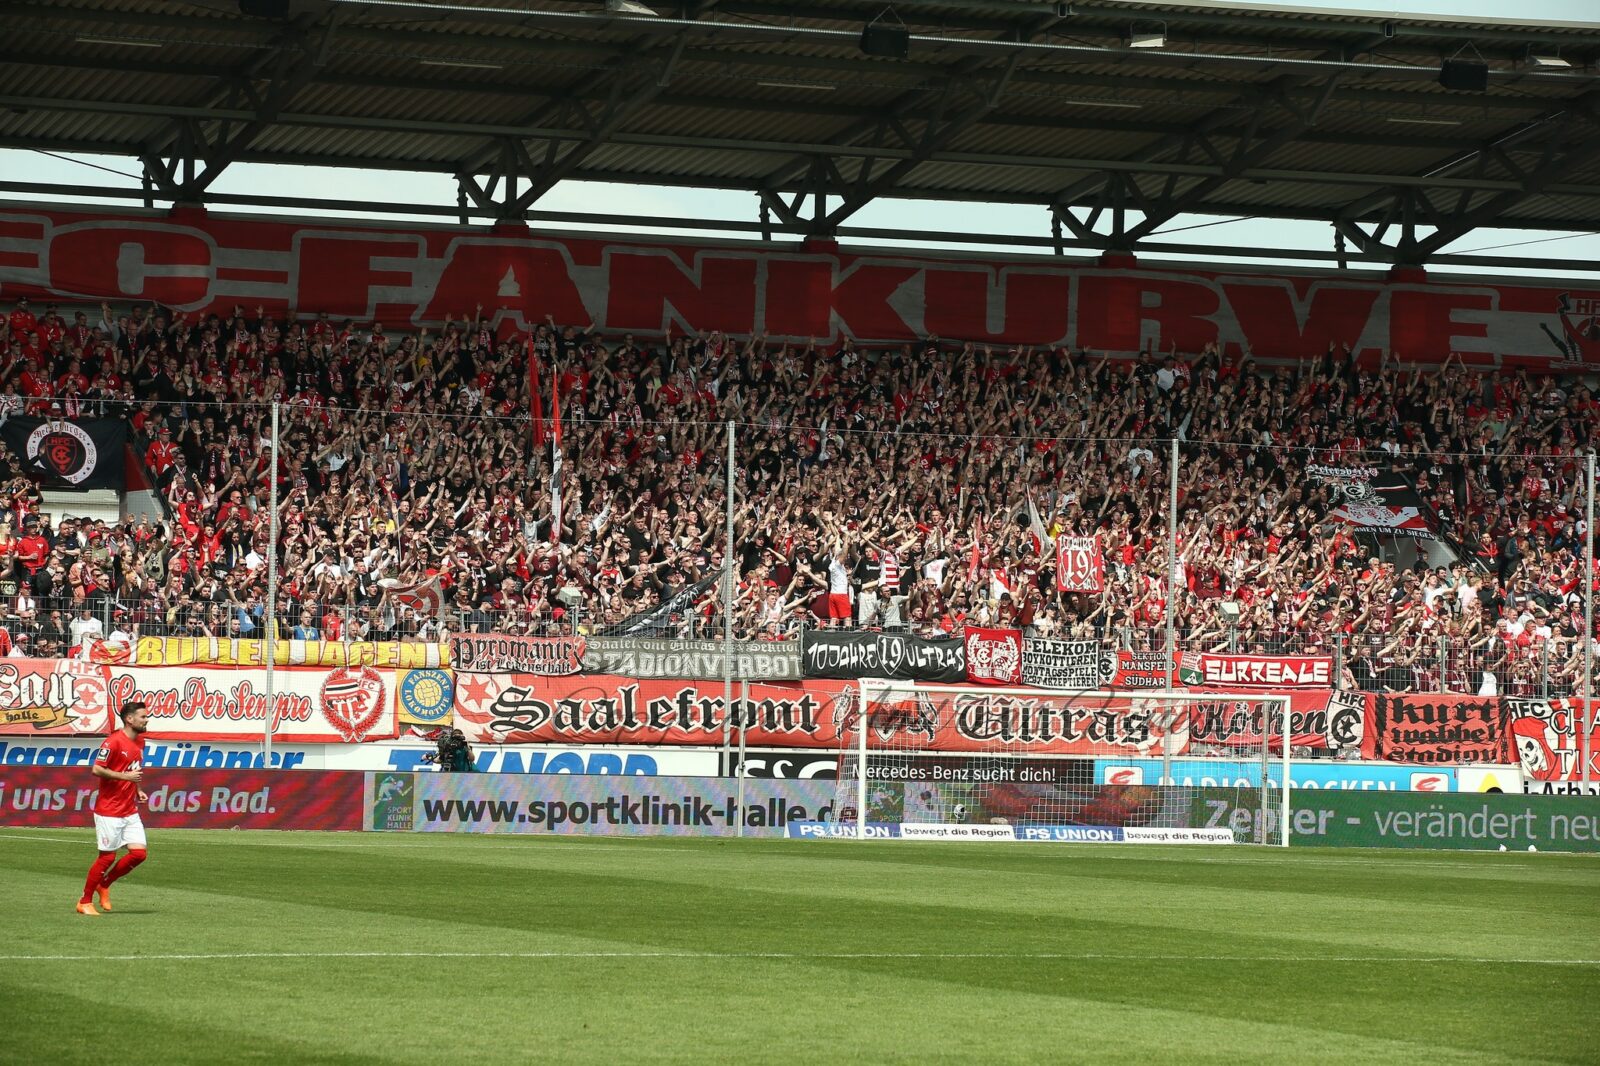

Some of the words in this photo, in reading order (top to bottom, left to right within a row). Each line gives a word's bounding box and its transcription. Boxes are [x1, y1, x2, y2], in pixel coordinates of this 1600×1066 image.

[137, 636, 290, 665] BULLEN
[304, 640, 427, 669] JAGEN
[451, 637, 574, 669] Pyromanie
[881, 638, 901, 668] 19
[906, 643, 965, 672] ULTRAS
[1131, 652, 1167, 661] SEKTION
[408, 670, 450, 691] FANSZENE
[1125, 674, 1168, 686] SÜDHAR
[1205, 659, 1330, 684] SURREALE
[180, 676, 227, 721] Per
[227, 679, 313, 734] Sempre
[404, 689, 450, 716] LOKOMOTIVE
[488, 683, 821, 734] Saalefront
[954, 693, 1154, 746] Ultras
[1190, 691, 1329, 742] Köthen
[143, 743, 305, 770] Hübner
[852, 764, 969, 780] Mercedes-Benz
[973, 766, 1017, 782] sucht
[1020, 766, 1056, 782] dich!
[13, 788, 68, 811] uns
[148, 785, 204, 814] das
[208, 786, 277, 814] Rad.
[387, 806, 413, 814] SPORT
[387, 814, 413, 822] KLINIK
[387, 821, 412, 829] HALLE
[1375, 804, 1536, 839] verändert
[800, 825, 826, 837] PS
[832, 826, 890, 838] UNON
[904, 827, 949, 837] bewegt
[951, 828, 969, 836] die
[971, 828, 1011, 838] Region
[1026, 827, 1051, 840] PS
[1055, 828, 1114, 841] UNION
[1127, 832, 1170, 841] bewegt
[1172, 832, 1189, 840] die
[1192, 832, 1232, 843] Region
